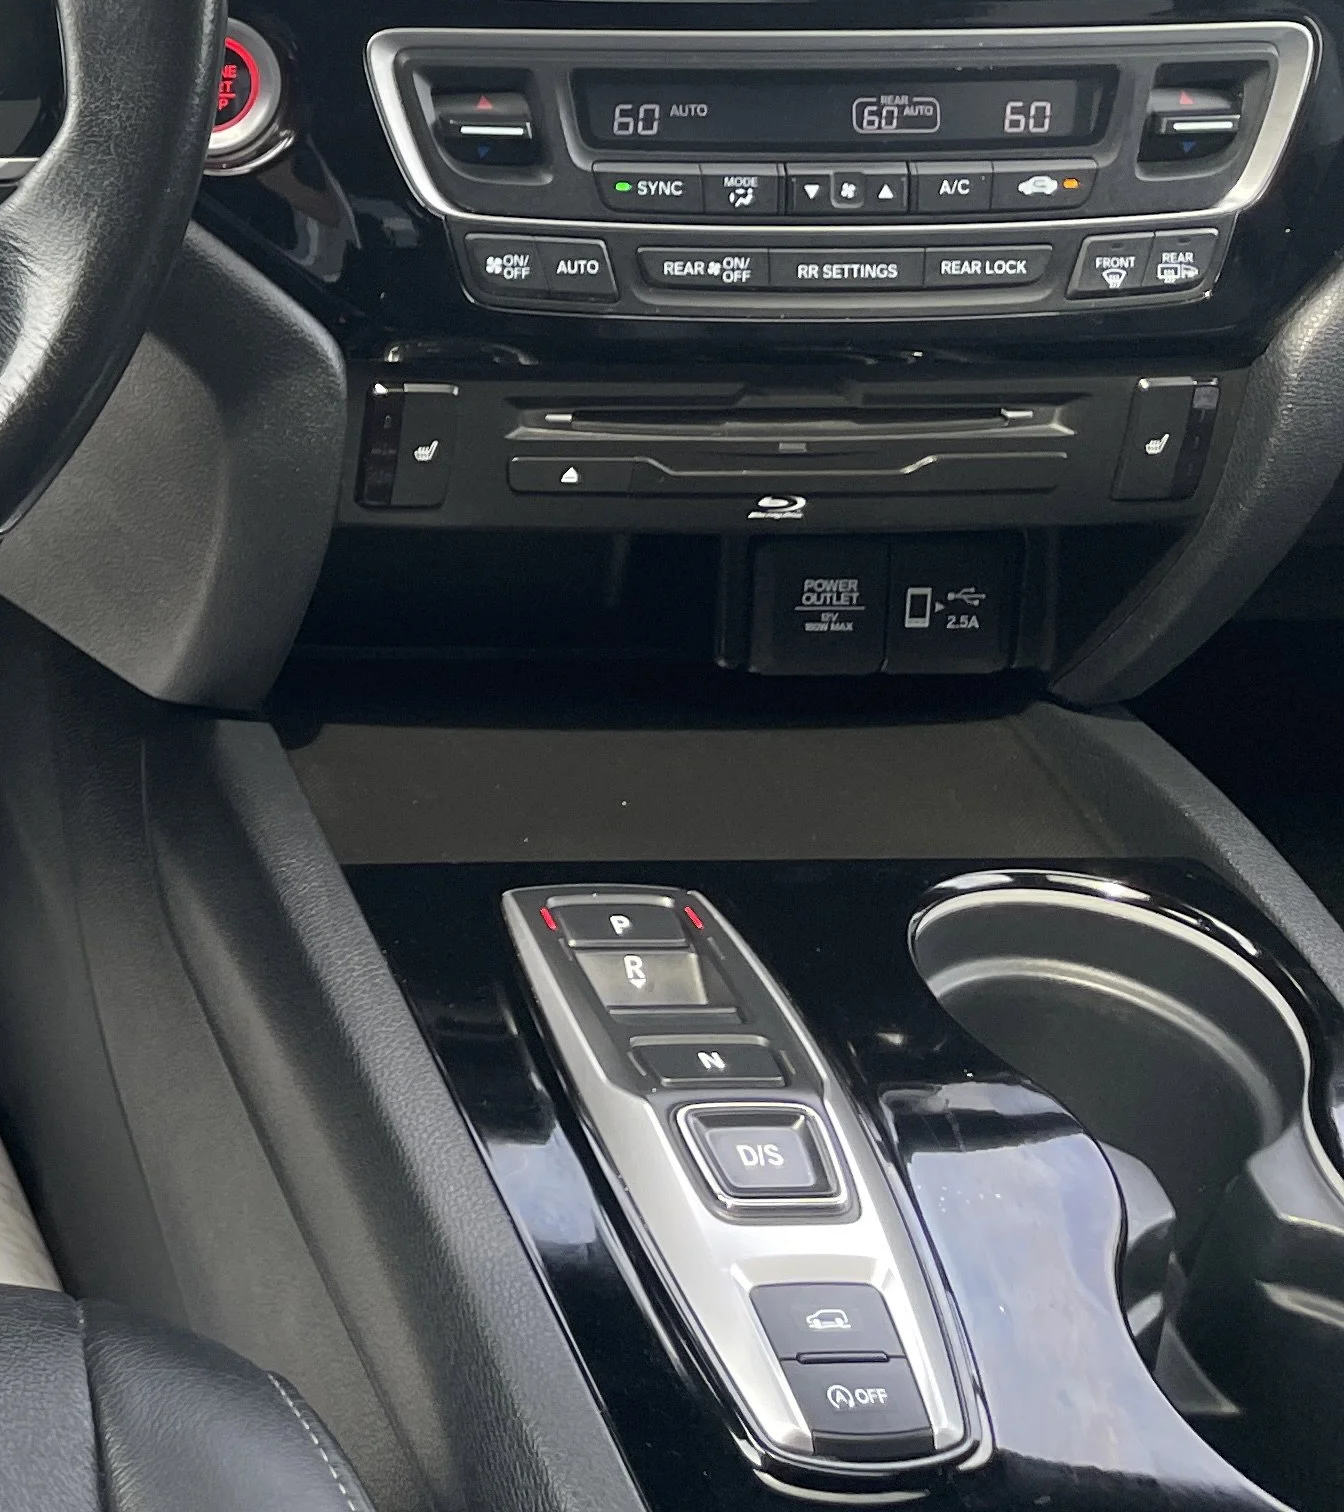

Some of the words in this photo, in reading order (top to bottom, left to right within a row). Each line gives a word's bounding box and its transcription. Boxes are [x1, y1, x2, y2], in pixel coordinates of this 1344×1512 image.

[880, 95, 909, 105] REAR
[613, 103, 660, 136] 60
[670, 104, 708, 117] AUTO
[862, 106, 899, 130] 60
[903, 104, 934, 116] AUTO
[1003, 100, 1052, 134] 60
[637, 180, 683, 196] SYNC
[723, 176, 759, 188] MODE
[939, 178, 970, 195] A/C
[503, 254, 530, 267] ON/
[722, 257, 750, 270] ON/
[1095, 255, 1136, 270] FRONT
[1161, 251, 1194, 264] REAR
[503, 266, 531, 280] OFF
[556, 259, 599, 275] AUTO
[663, 262, 705, 276] REAR
[797, 265, 819, 279] RR
[822, 264, 898, 280] SETTINGS
[941, 260, 982, 276] REAR
[985, 259, 1027, 276] LOCK
[722, 269, 752, 283] OFF
[804, 579, 859, 593] POWER
[801, 592, 860, 606] OUTLET
[946, 614, 980, 630] 2.5A
[609, 915, 631, 935] P
[624, 954, 646, 980] R
[697, 1051, 726, 1072] N
[736, 1144, 785, 1167] D/S
[854, 1387, 889, 1406] OFF
